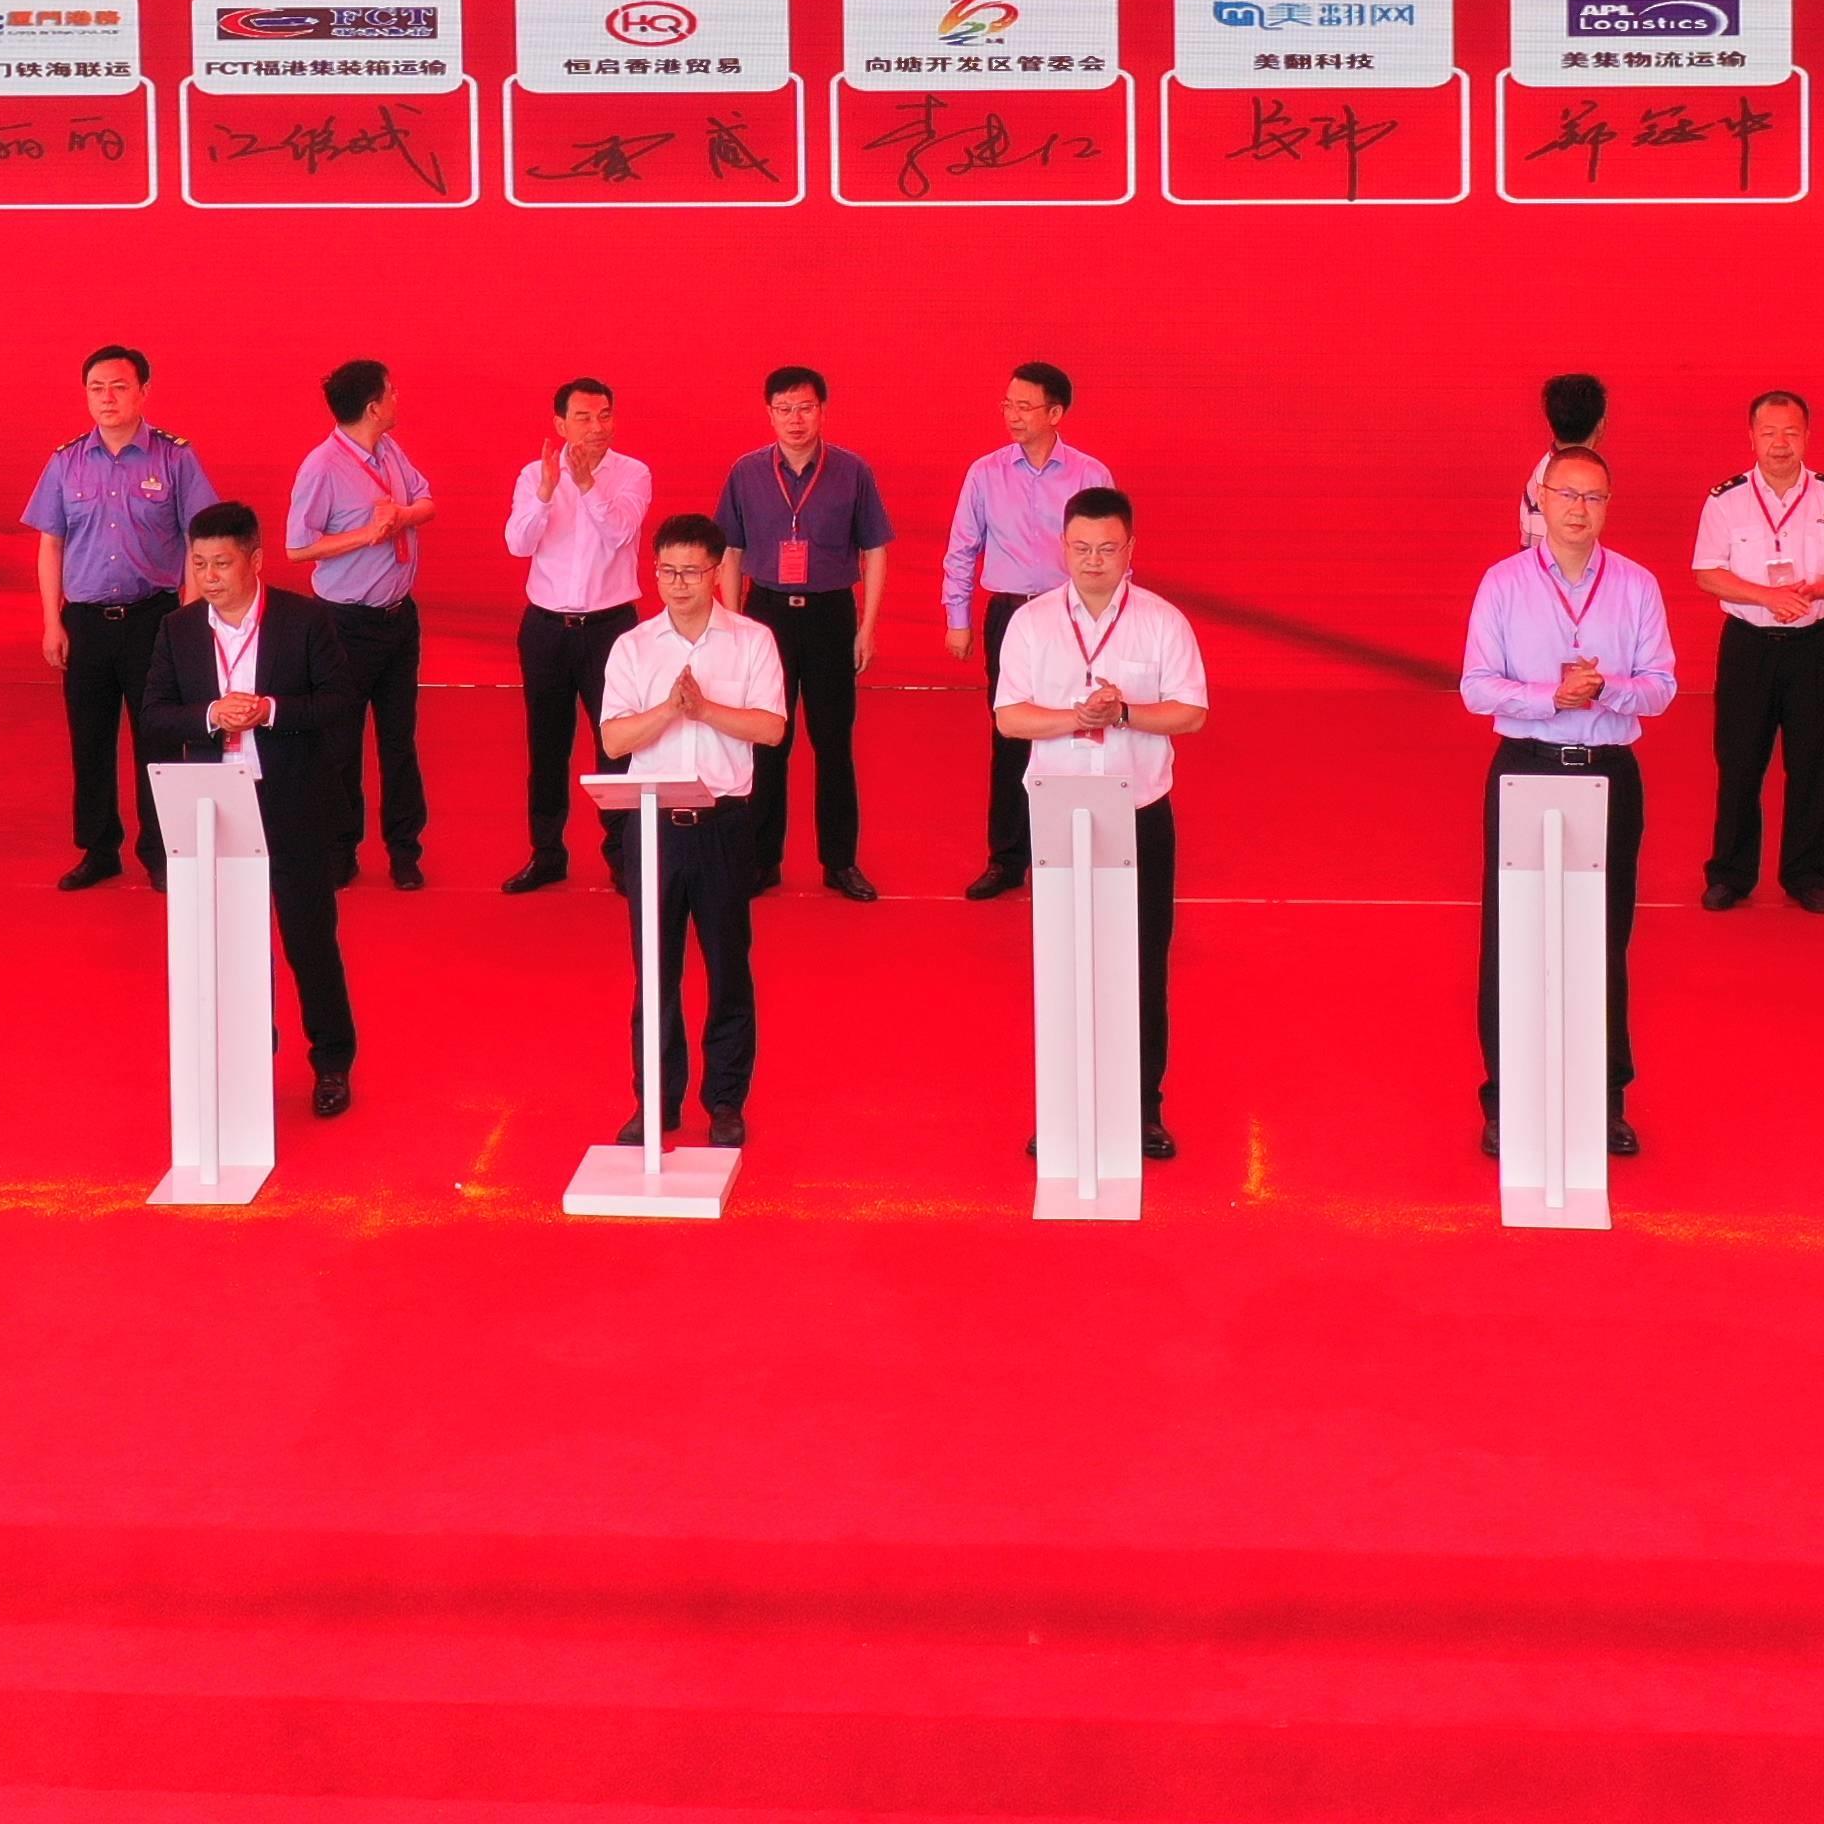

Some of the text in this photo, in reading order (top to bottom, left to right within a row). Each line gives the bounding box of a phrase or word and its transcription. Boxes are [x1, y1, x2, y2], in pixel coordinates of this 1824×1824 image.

[329, 7, 434, 26] FCT
[1579, 4, 1635, 16] APL
[1579, 17, 1709, 32] Logistics
[205, 59, 448, 77] FCT福港集装箱运输
[563, 57, 743, 75] 恒启香港贸易
[865, 55, 1106, 73] 向塘开发区管委会
[1253, 53, 1375, 70] 美翻科技
[1561, 50, 1748, 69] 美集物流运输
